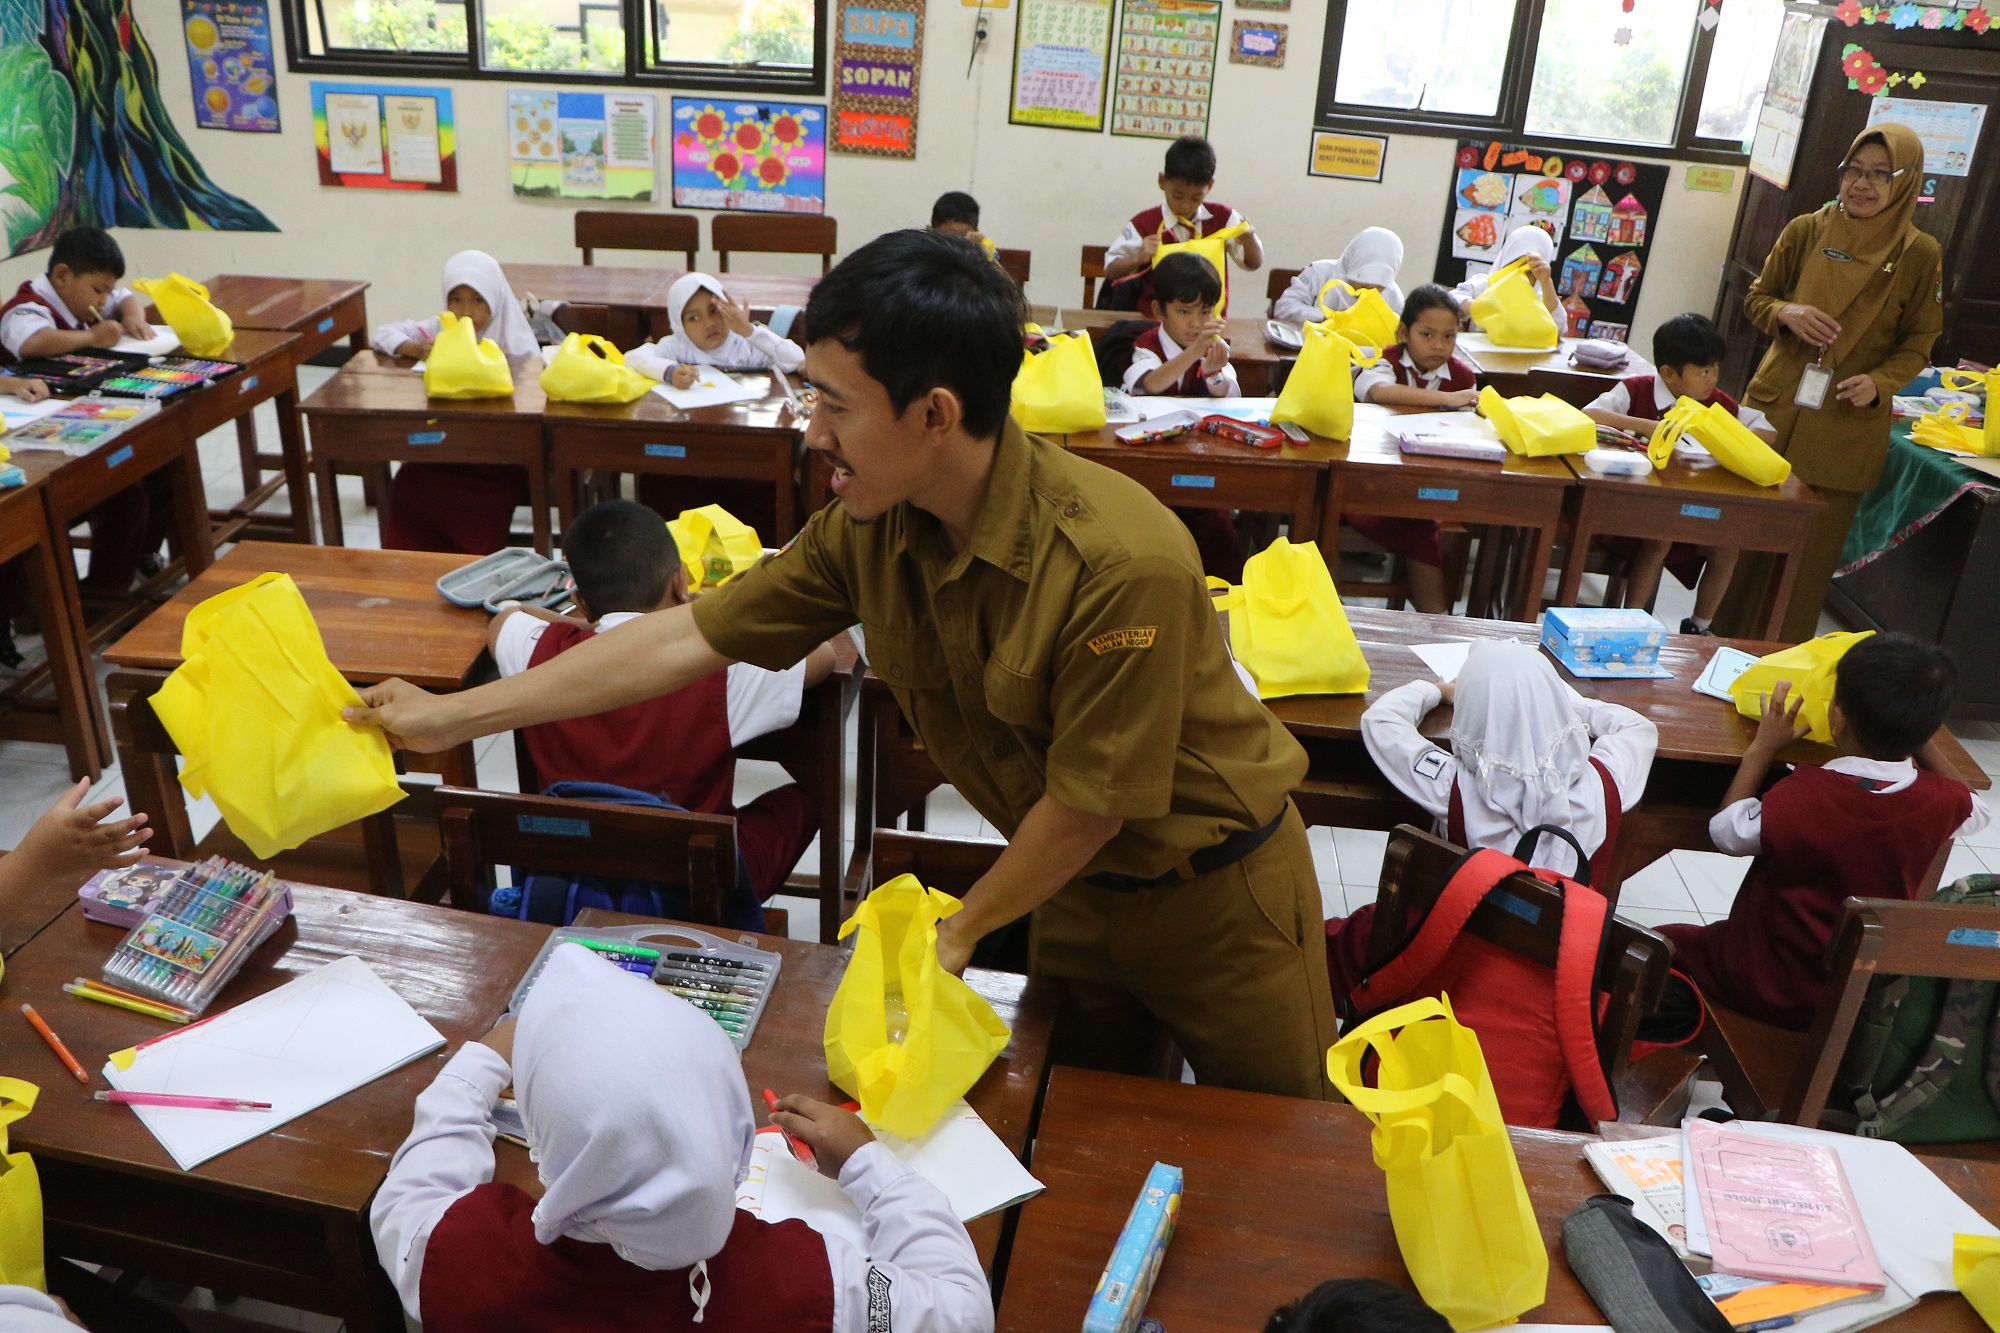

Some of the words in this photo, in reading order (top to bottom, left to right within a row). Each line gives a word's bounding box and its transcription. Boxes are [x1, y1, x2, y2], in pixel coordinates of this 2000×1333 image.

[849, 13, 909, 38] SAPA
[842, 67, 911, 89] SOPAN
[1090, 629, 1154, 647] KEMENTERIAN
[1098, 640, 1123, 653] DALAM
[1766, 1197, 1813, 1212] NEGERI
